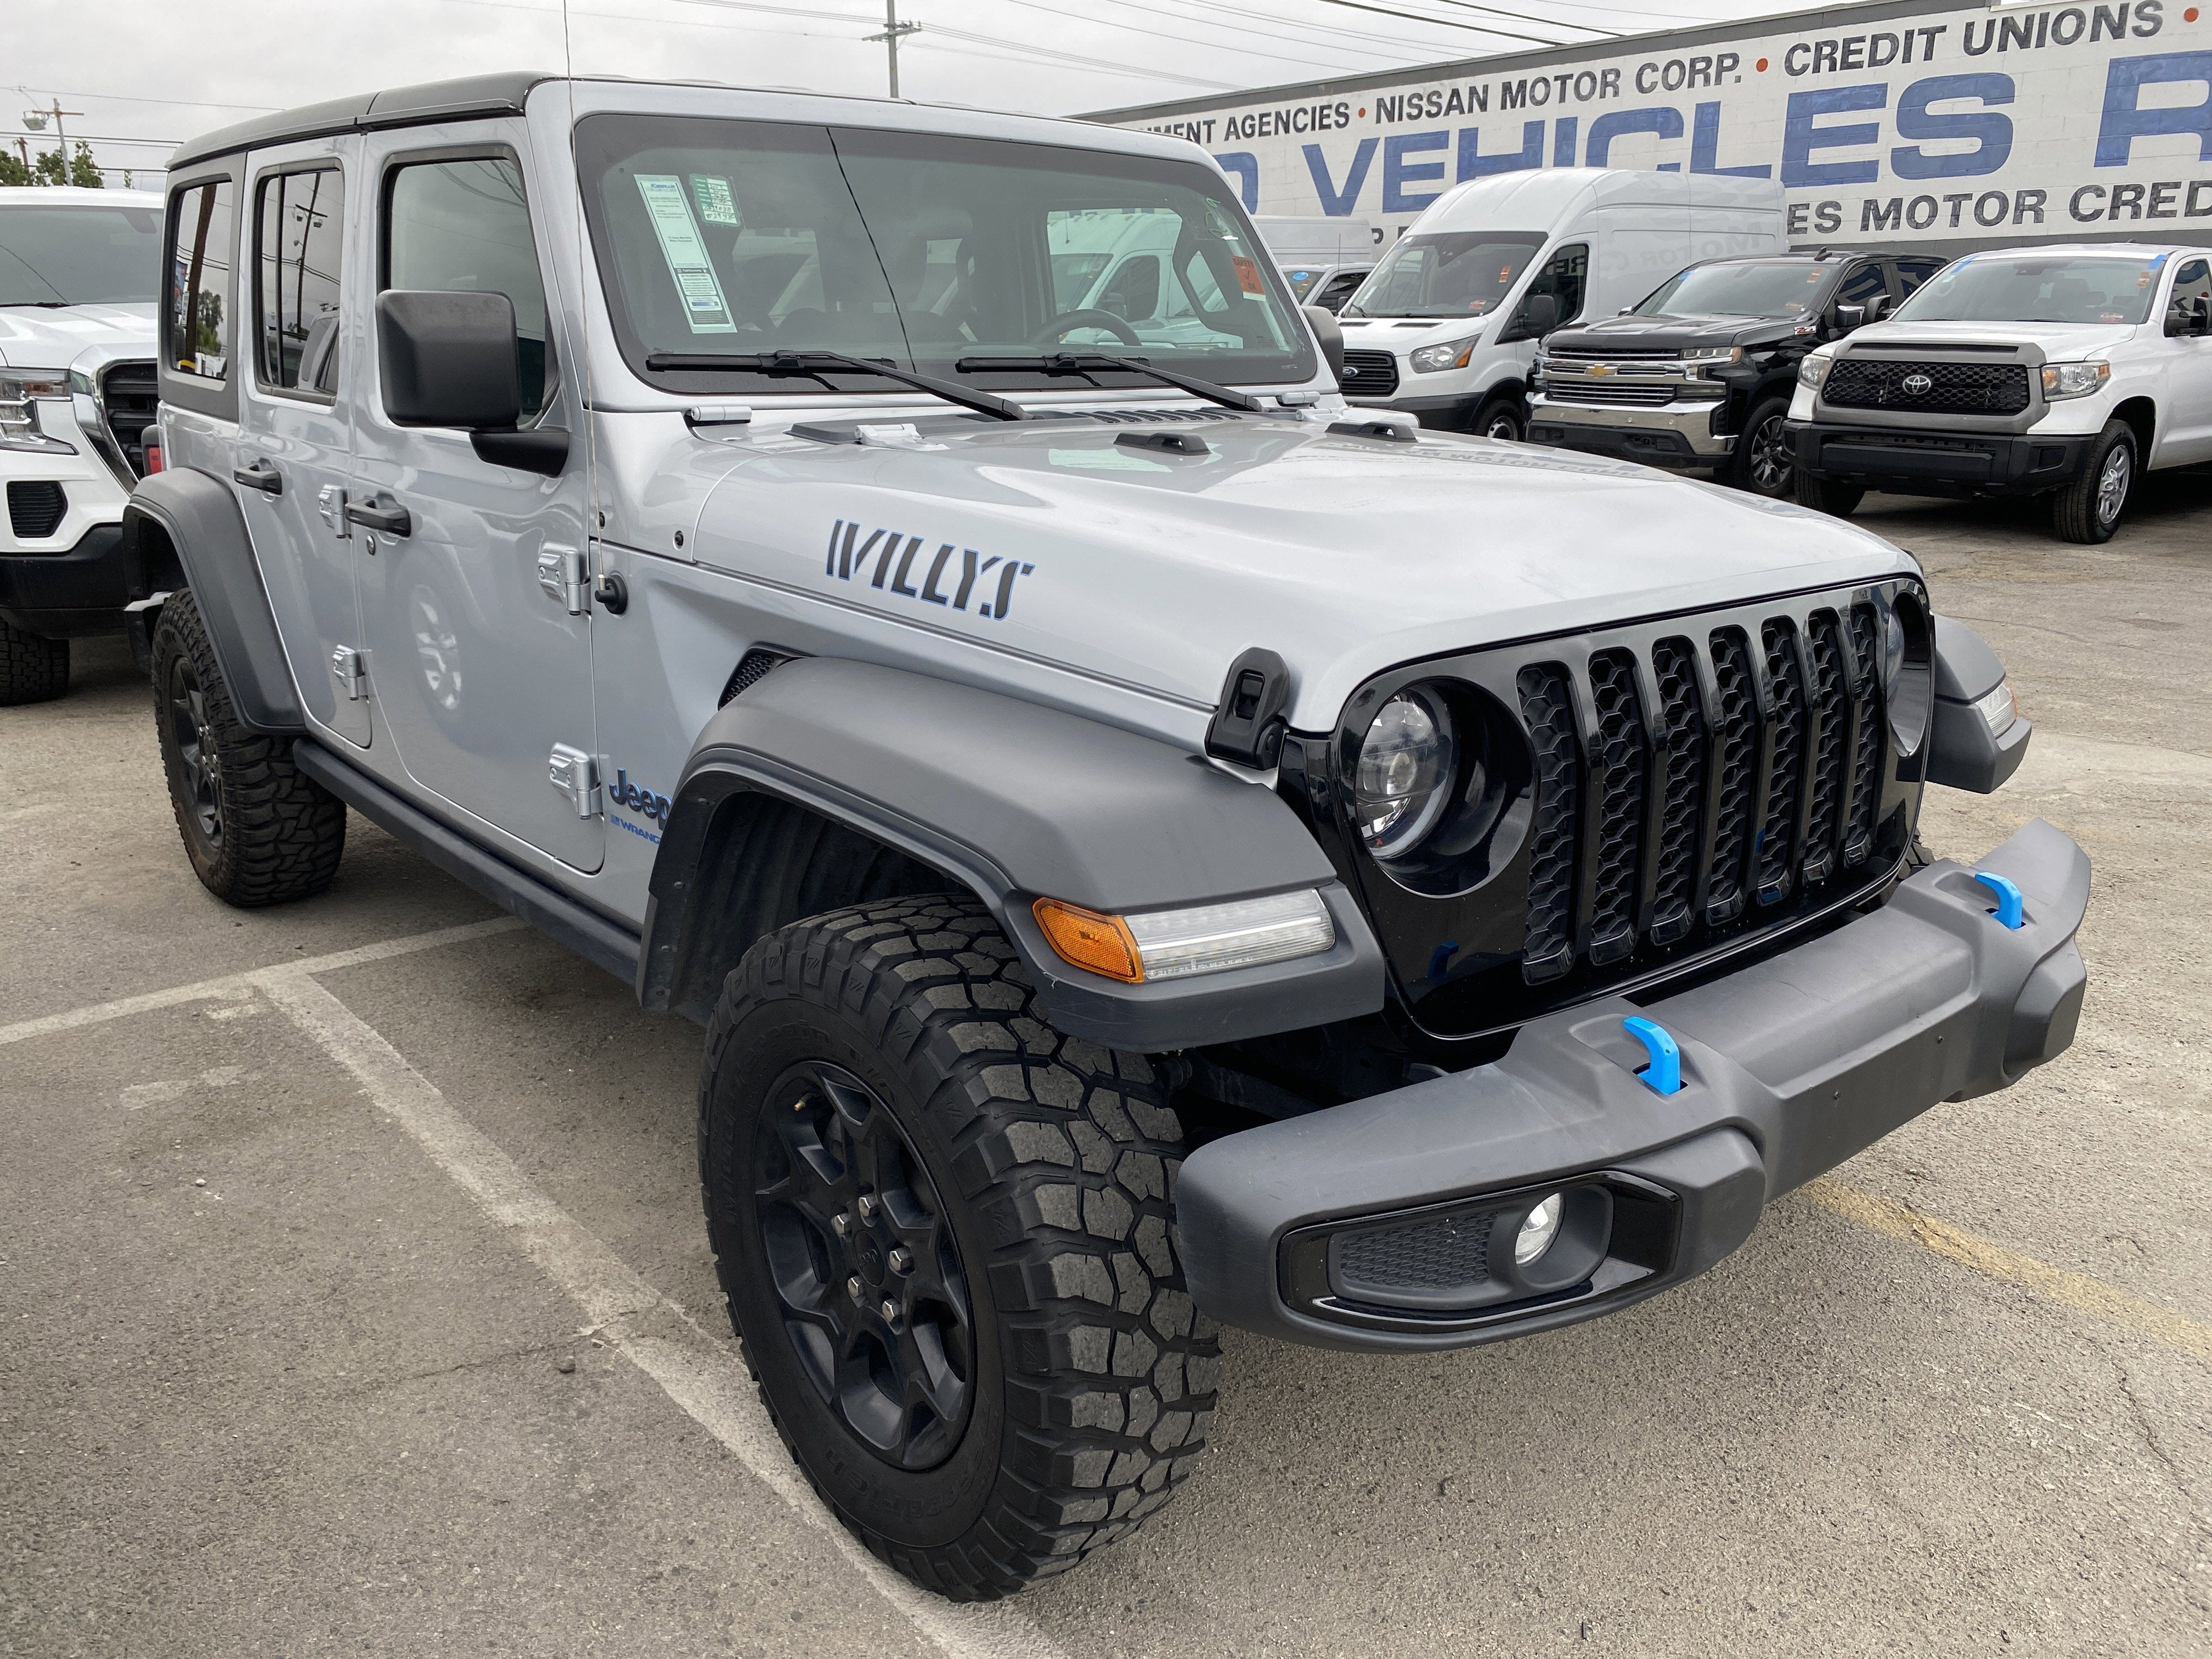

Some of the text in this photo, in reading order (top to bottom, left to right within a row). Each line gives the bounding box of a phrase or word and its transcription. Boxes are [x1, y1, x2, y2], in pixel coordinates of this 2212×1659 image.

[1224, 102, 1350, 142] AGENCIES
[1376, 84, 1488, 124] NISSAN
[1500, 68, 1620, 110] MOTOR
[1635, 53, 1741, 94] CORP.
[1784, 25, 1947, 76] CREDIT
[1963, 1, 2163, 56] UNIONS
[1301, 72, 2015, 216] VEHICLES
[1860, 189, 2047, 232] MOTOR
[826, 519, 1036, 621] WILLYS
[609, 767, 672, 831] Jeep
